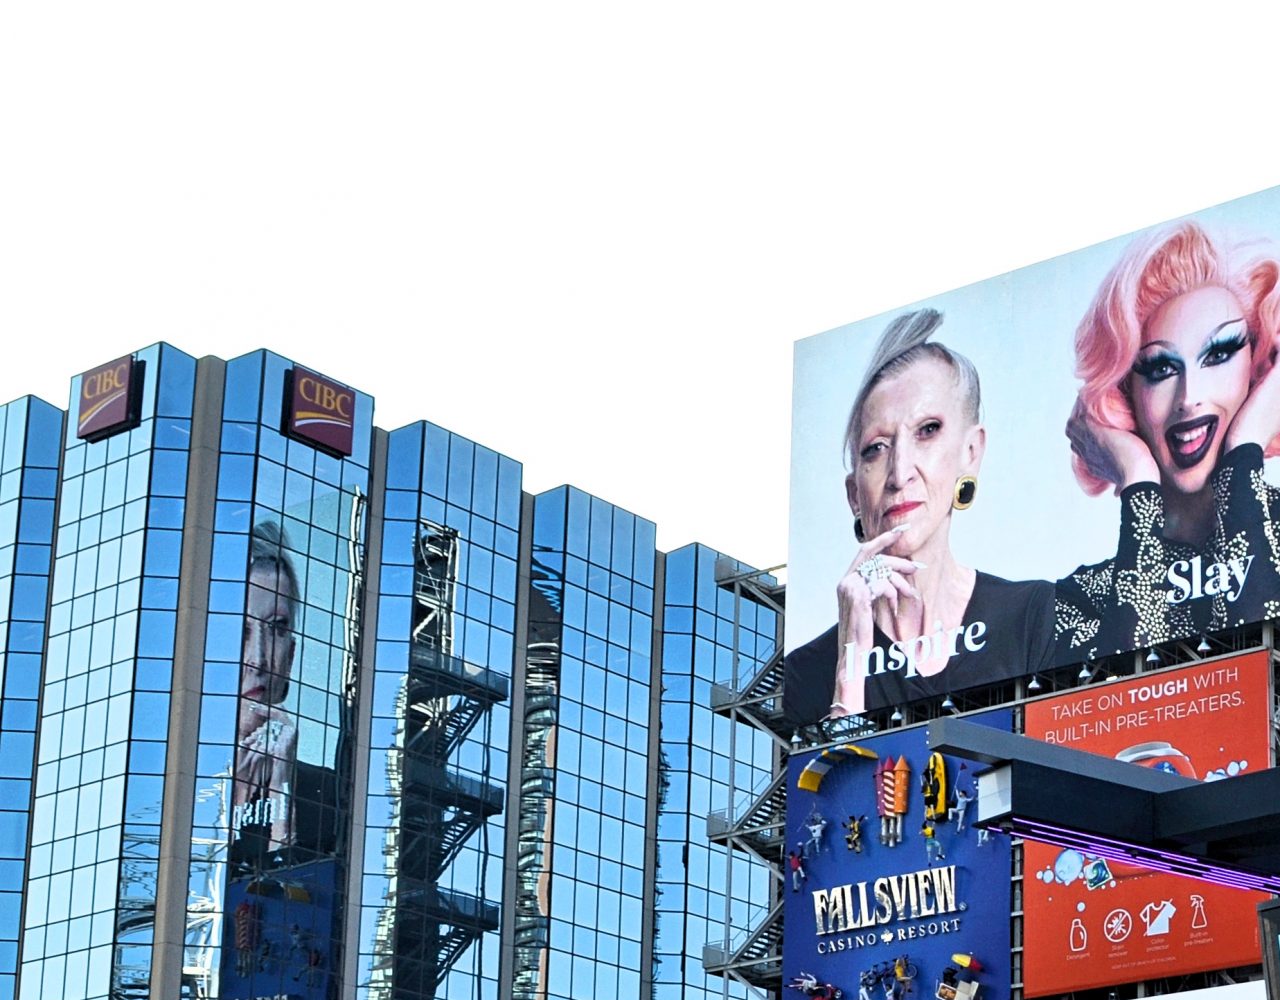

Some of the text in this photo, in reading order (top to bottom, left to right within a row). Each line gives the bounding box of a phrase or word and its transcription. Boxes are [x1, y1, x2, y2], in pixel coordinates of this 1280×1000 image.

[83, 363, 127, 400] CIBC
[299, 376, 351, 418] CIBC
[1165, 552, 1255, 604] Slay
[843, 620, 987, 683] Inspire
[1045, 690, 1245, 744] BUILT-IN PRE-TREATERS.
[1051, 667, 1239, 721] TAKE ON TOUGH WITH
[812, 865, 959, 936] FALLSVIEW
[816, 918, 961, 955] CASINO RESORT
